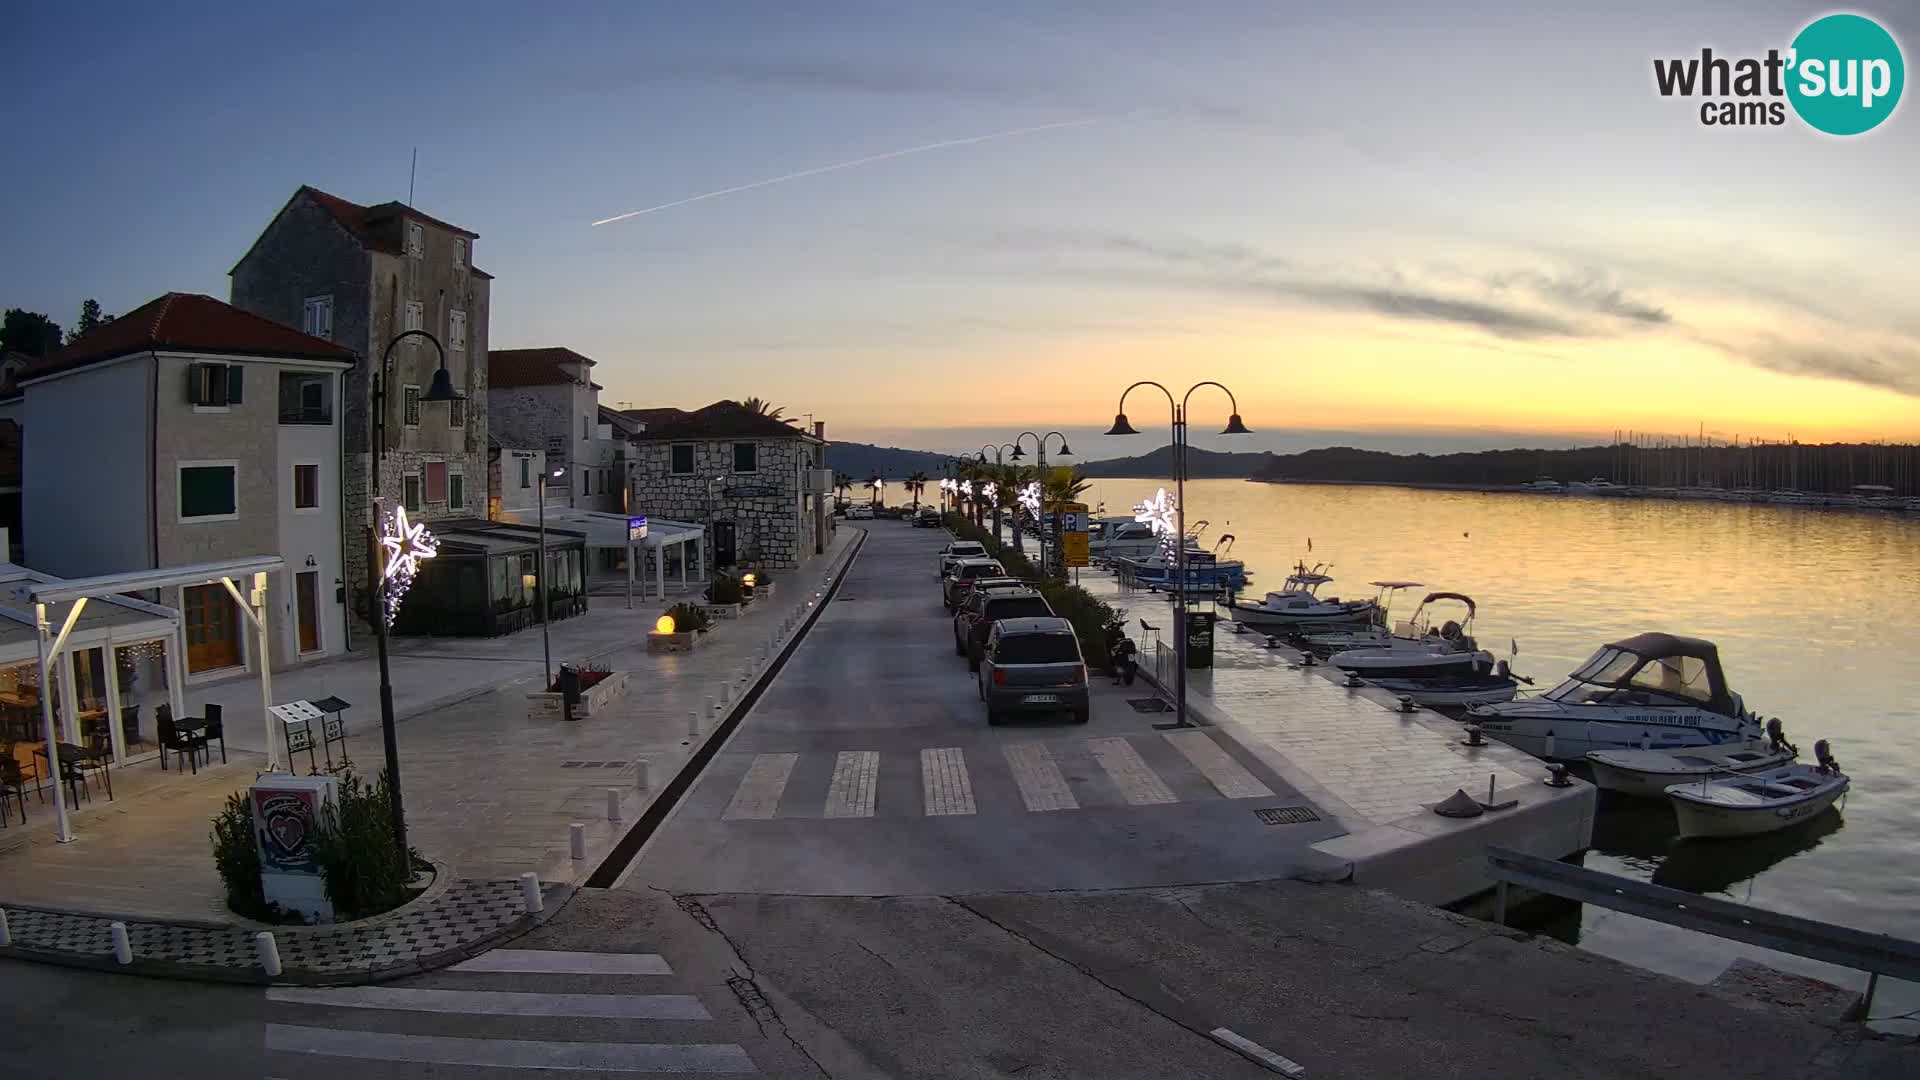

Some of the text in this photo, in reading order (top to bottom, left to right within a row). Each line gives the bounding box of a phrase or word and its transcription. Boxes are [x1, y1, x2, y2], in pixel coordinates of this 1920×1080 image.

[1065, 514, 1076, 530] P
[1658, 715, 1677, 724] RENT
[1684, 715, 1702, 725] BOAT
